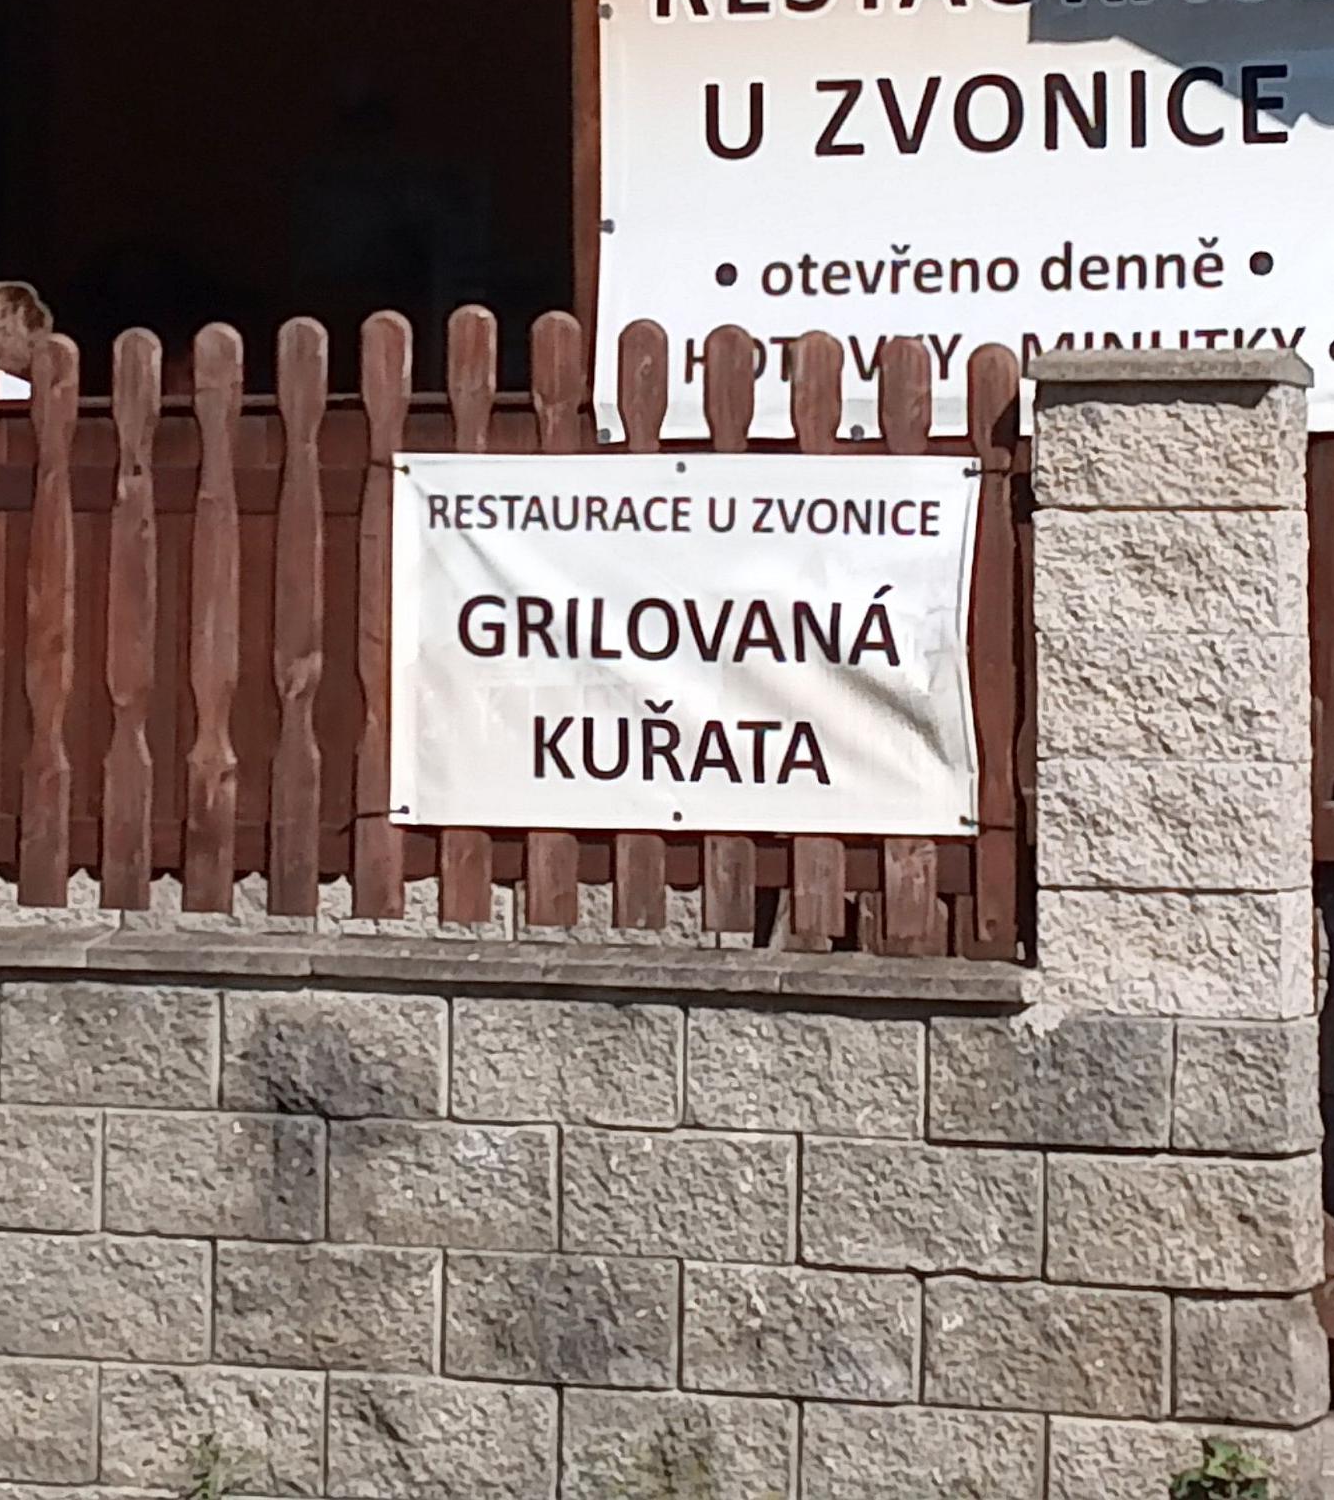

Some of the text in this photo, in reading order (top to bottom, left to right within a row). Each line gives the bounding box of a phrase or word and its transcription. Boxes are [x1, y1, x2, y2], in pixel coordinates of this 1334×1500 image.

[704, 63, 1291, 161] U ZVONICE
[760, 236, 1226, 297] otevřeno denně
[428, 494, 942, 537] RESTAURACE U ZVONICE
[457, 584, 902, 667] GRILOVANÁ
[533, 699, 832, 786] KUŘATA
